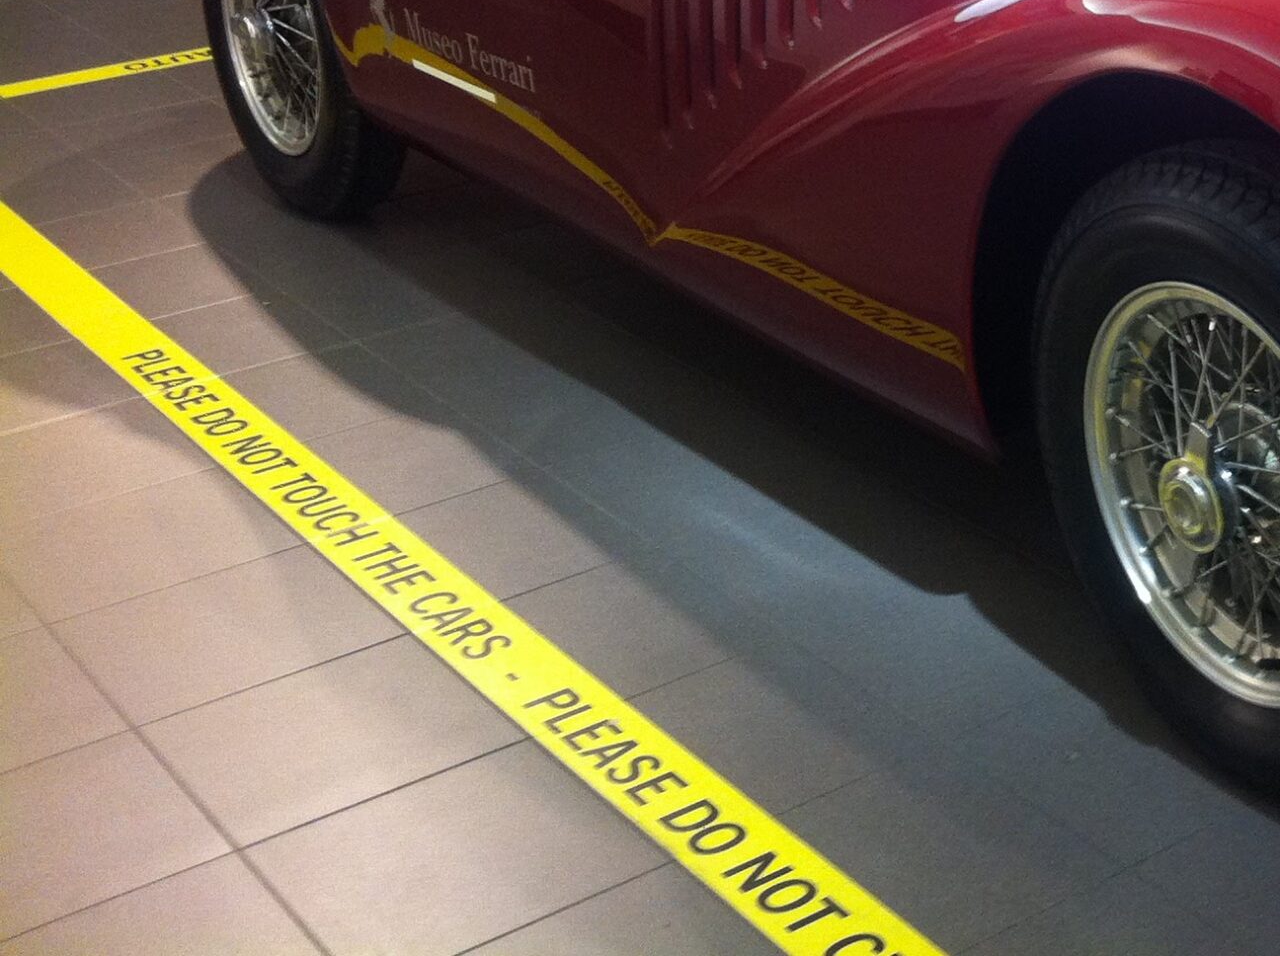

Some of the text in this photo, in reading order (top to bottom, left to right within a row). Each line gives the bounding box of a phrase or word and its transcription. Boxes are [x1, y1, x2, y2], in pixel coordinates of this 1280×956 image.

[403, 7, 536, 93] Museo Ferrari
[122, 348, 219, 412] PLEASE
[191, 407, 249, 437] DO
[220, 434, 299, 475] NOT
[270, 472, 379, 547] TOUCH
[351, 541, 437, 596] THE
[408, 590, 511, 661] CARS
[522, 687, 689, 807] PLEASE
[658, 798, 747, 856] DO
[721, 850, 849, 933] NOT
